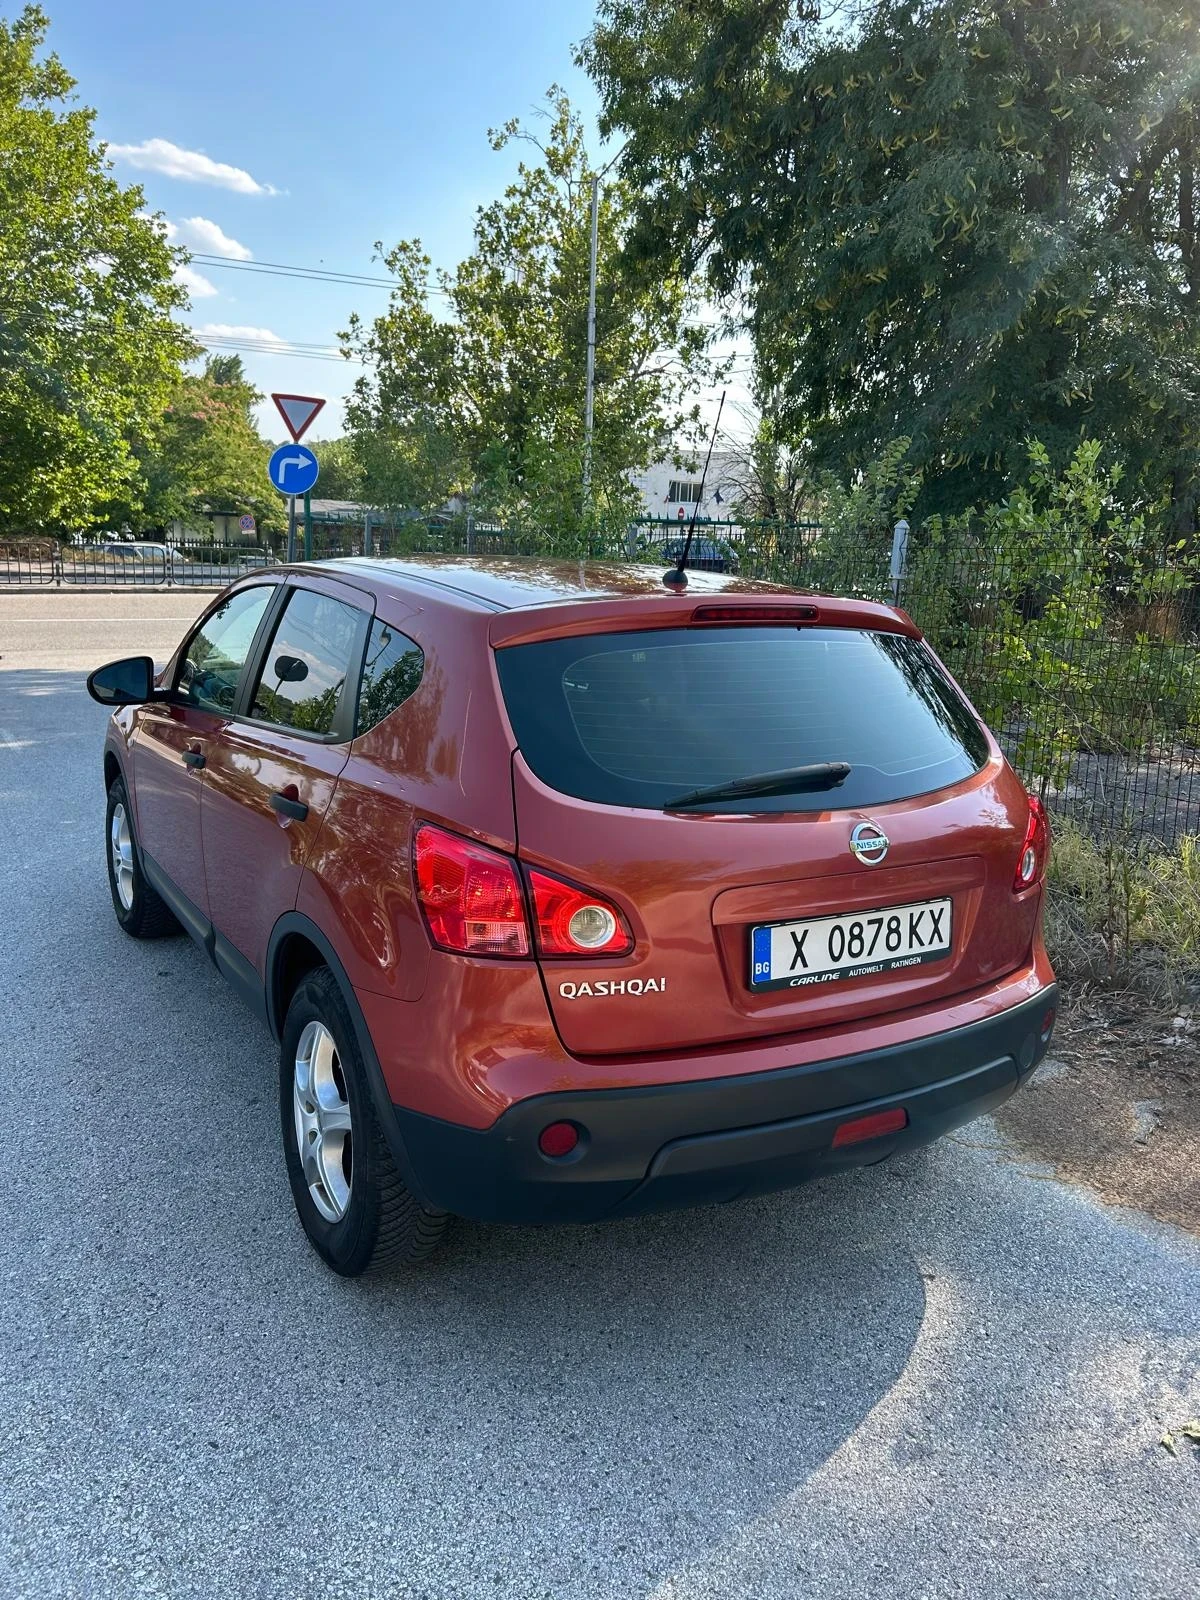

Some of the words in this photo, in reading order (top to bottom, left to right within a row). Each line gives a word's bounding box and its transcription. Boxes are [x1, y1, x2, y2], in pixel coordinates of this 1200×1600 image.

[789, 929, 809, 970] X
[755, 961, 770, 975] BG
[789, 972, 840, 987] CARLINE
[848, 964, 884, 977] AUTOWELT
[891, 956, 922, 969] RATINGEN
[559, 977, 666, 1000] QASHQAI
